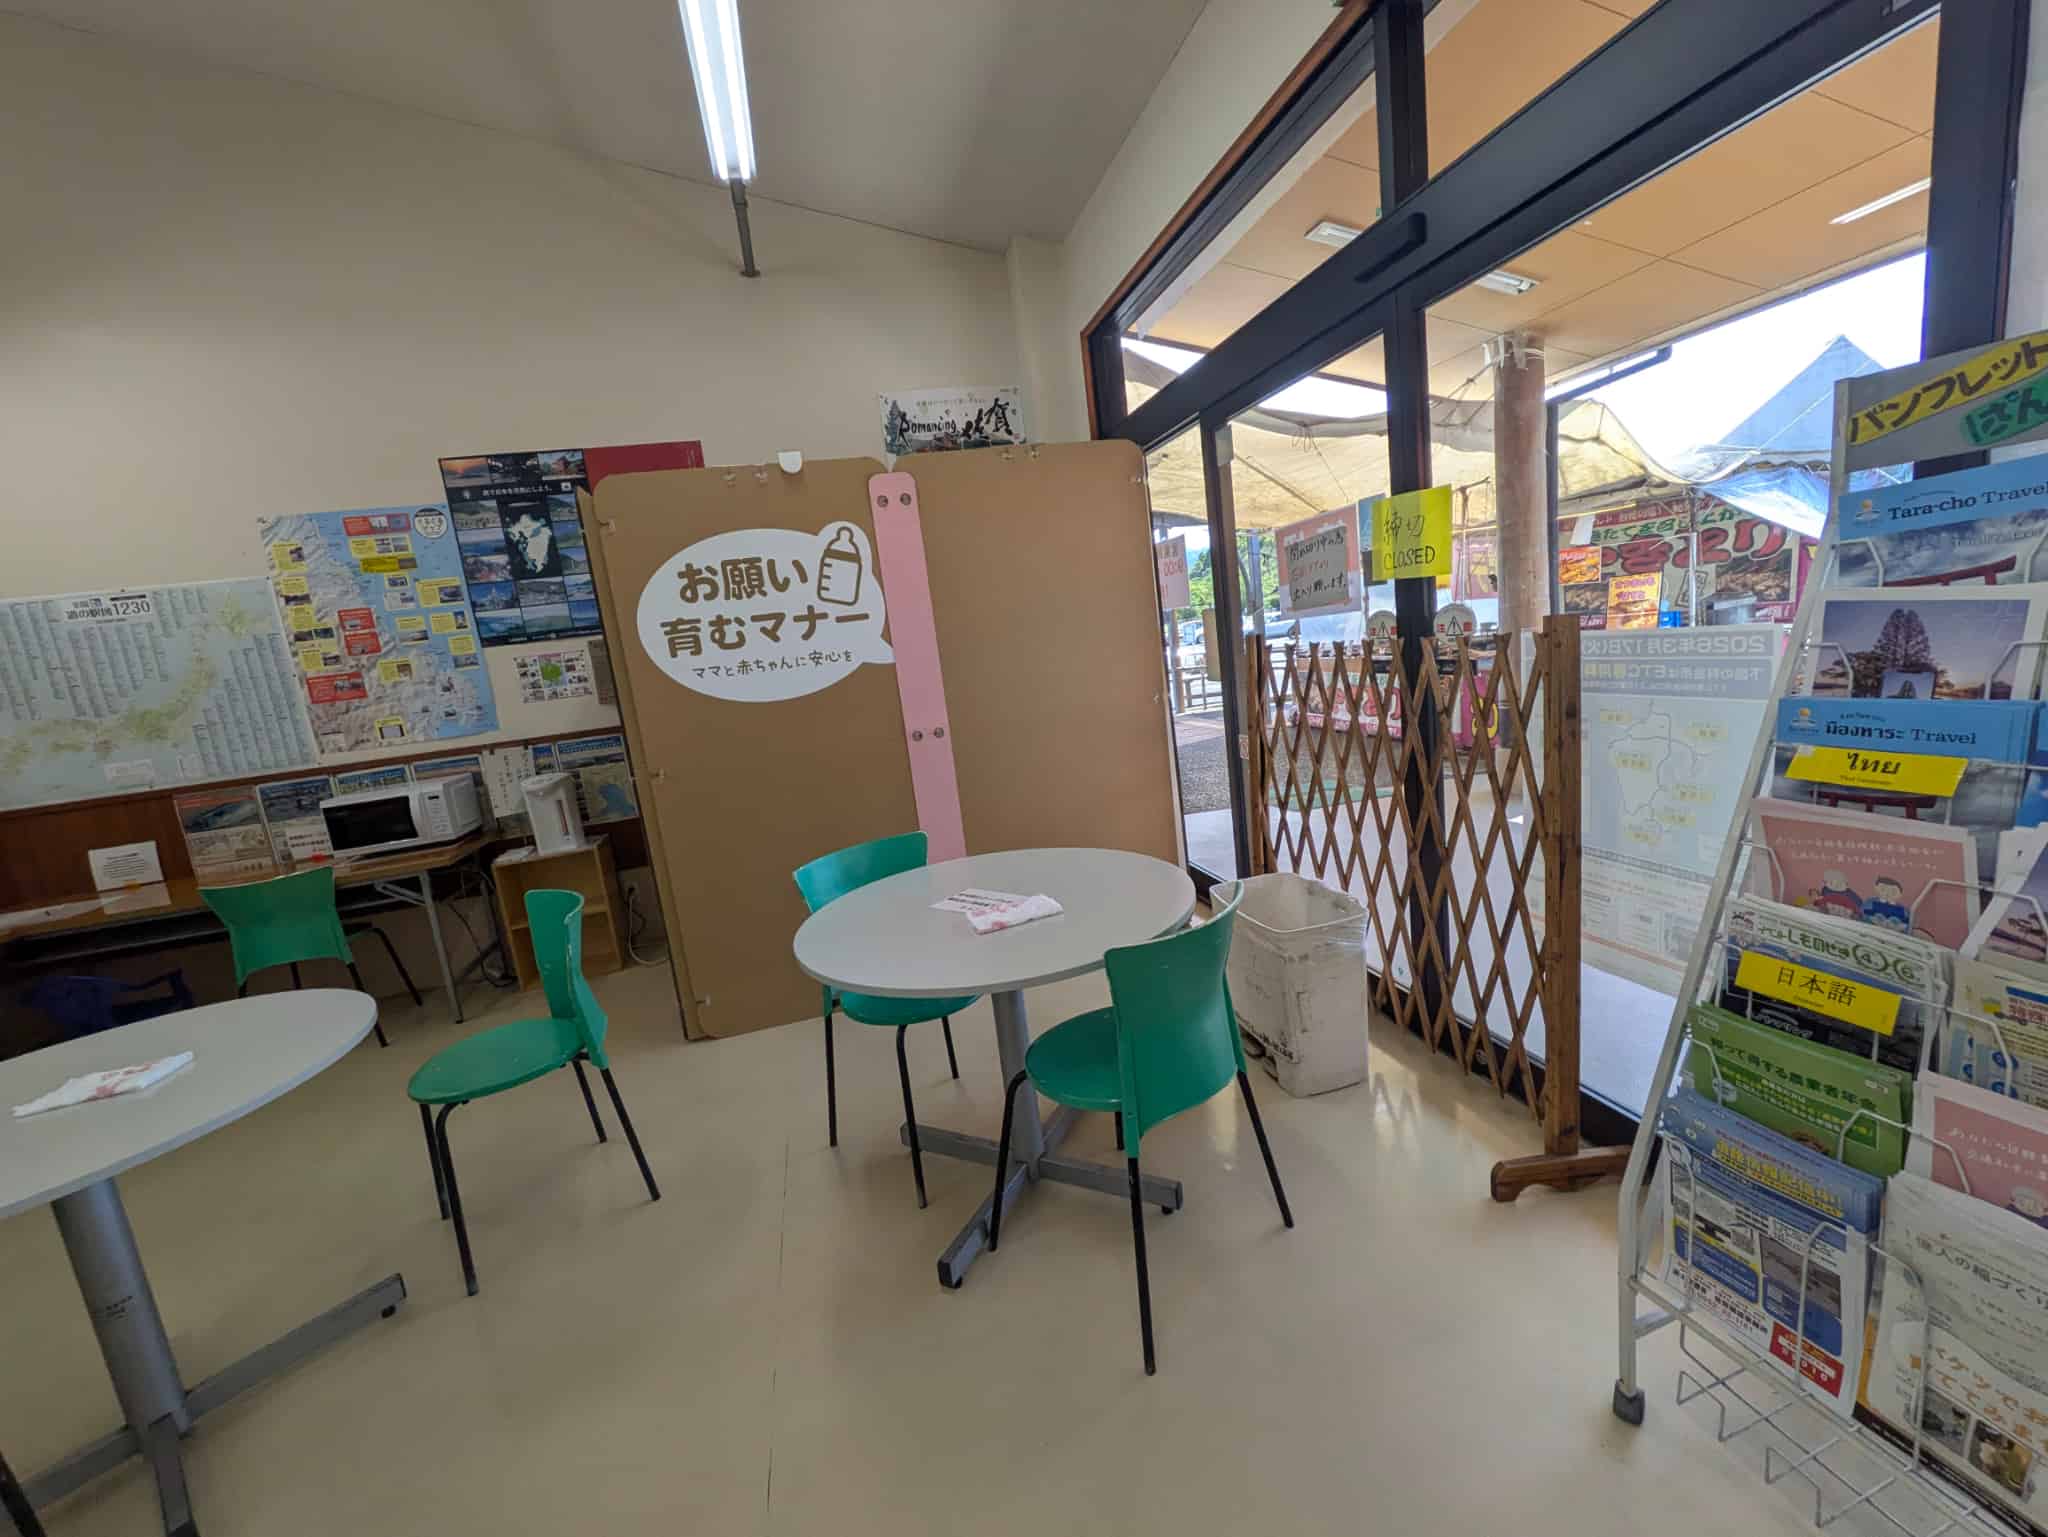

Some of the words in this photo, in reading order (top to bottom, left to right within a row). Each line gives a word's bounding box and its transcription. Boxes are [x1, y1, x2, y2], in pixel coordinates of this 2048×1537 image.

[1888, 495, 1977, 521] Tara-cho
[1981, 483, 2048, 504] Travel
[1382, 545, 1436, 571] CLOSED
[677, 556, 808, 604] お願い
[660, 604, 870, 660] 育むマナー
[692, 649, 853, 679] ママと赤ちゃんに安心を
[1910, 728, 1977, 745] Travel
[1847, 752, 1902, 775] ไทย
[1777, 966, 1857, 1007] 日本語
